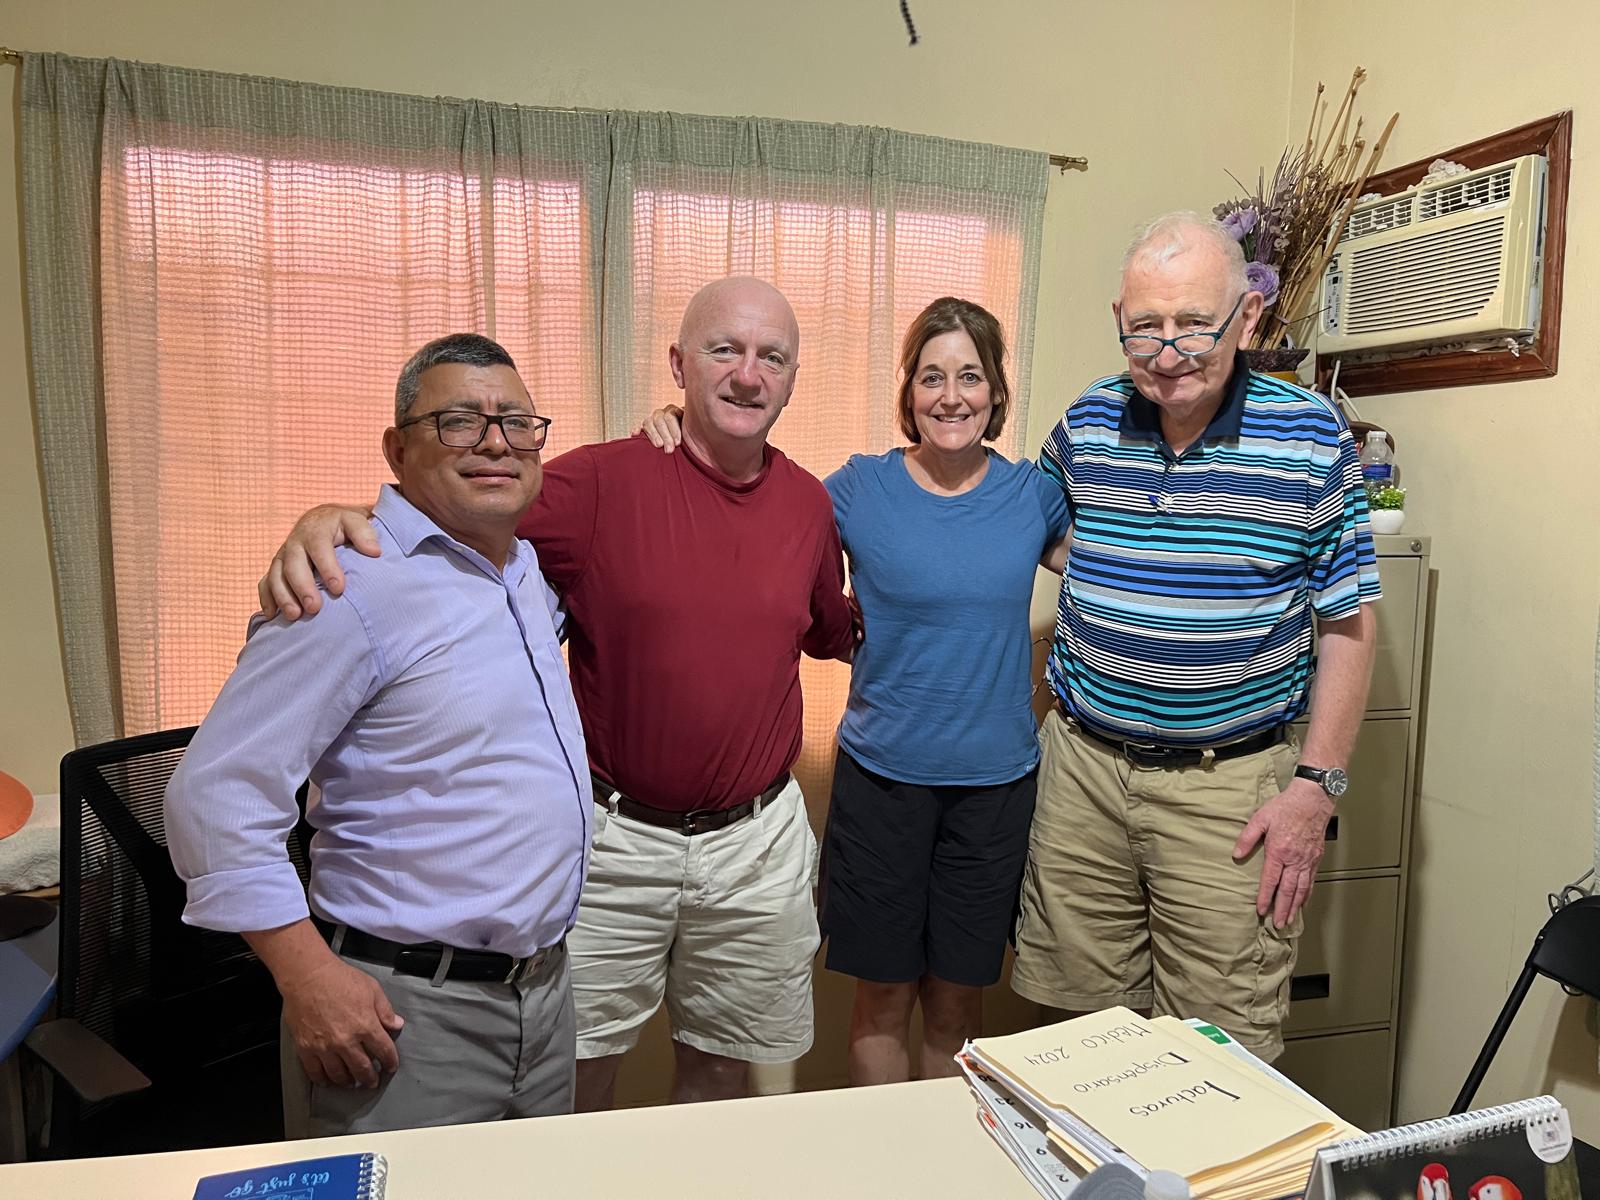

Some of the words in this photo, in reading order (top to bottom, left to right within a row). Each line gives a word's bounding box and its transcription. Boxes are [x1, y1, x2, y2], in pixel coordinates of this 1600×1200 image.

[1024, 1046, 1069, 1066] 2024
[1074, 1052, 1191, 1093] Dispensario
[1036, 1147, 1047, 1155] 9
[256, 1173, 296, 1194] just
[301, 1171, 329, 1185] let's
[1056, 1173, 1069, 1183] 2
[224, 1180, 253, 1198] go
